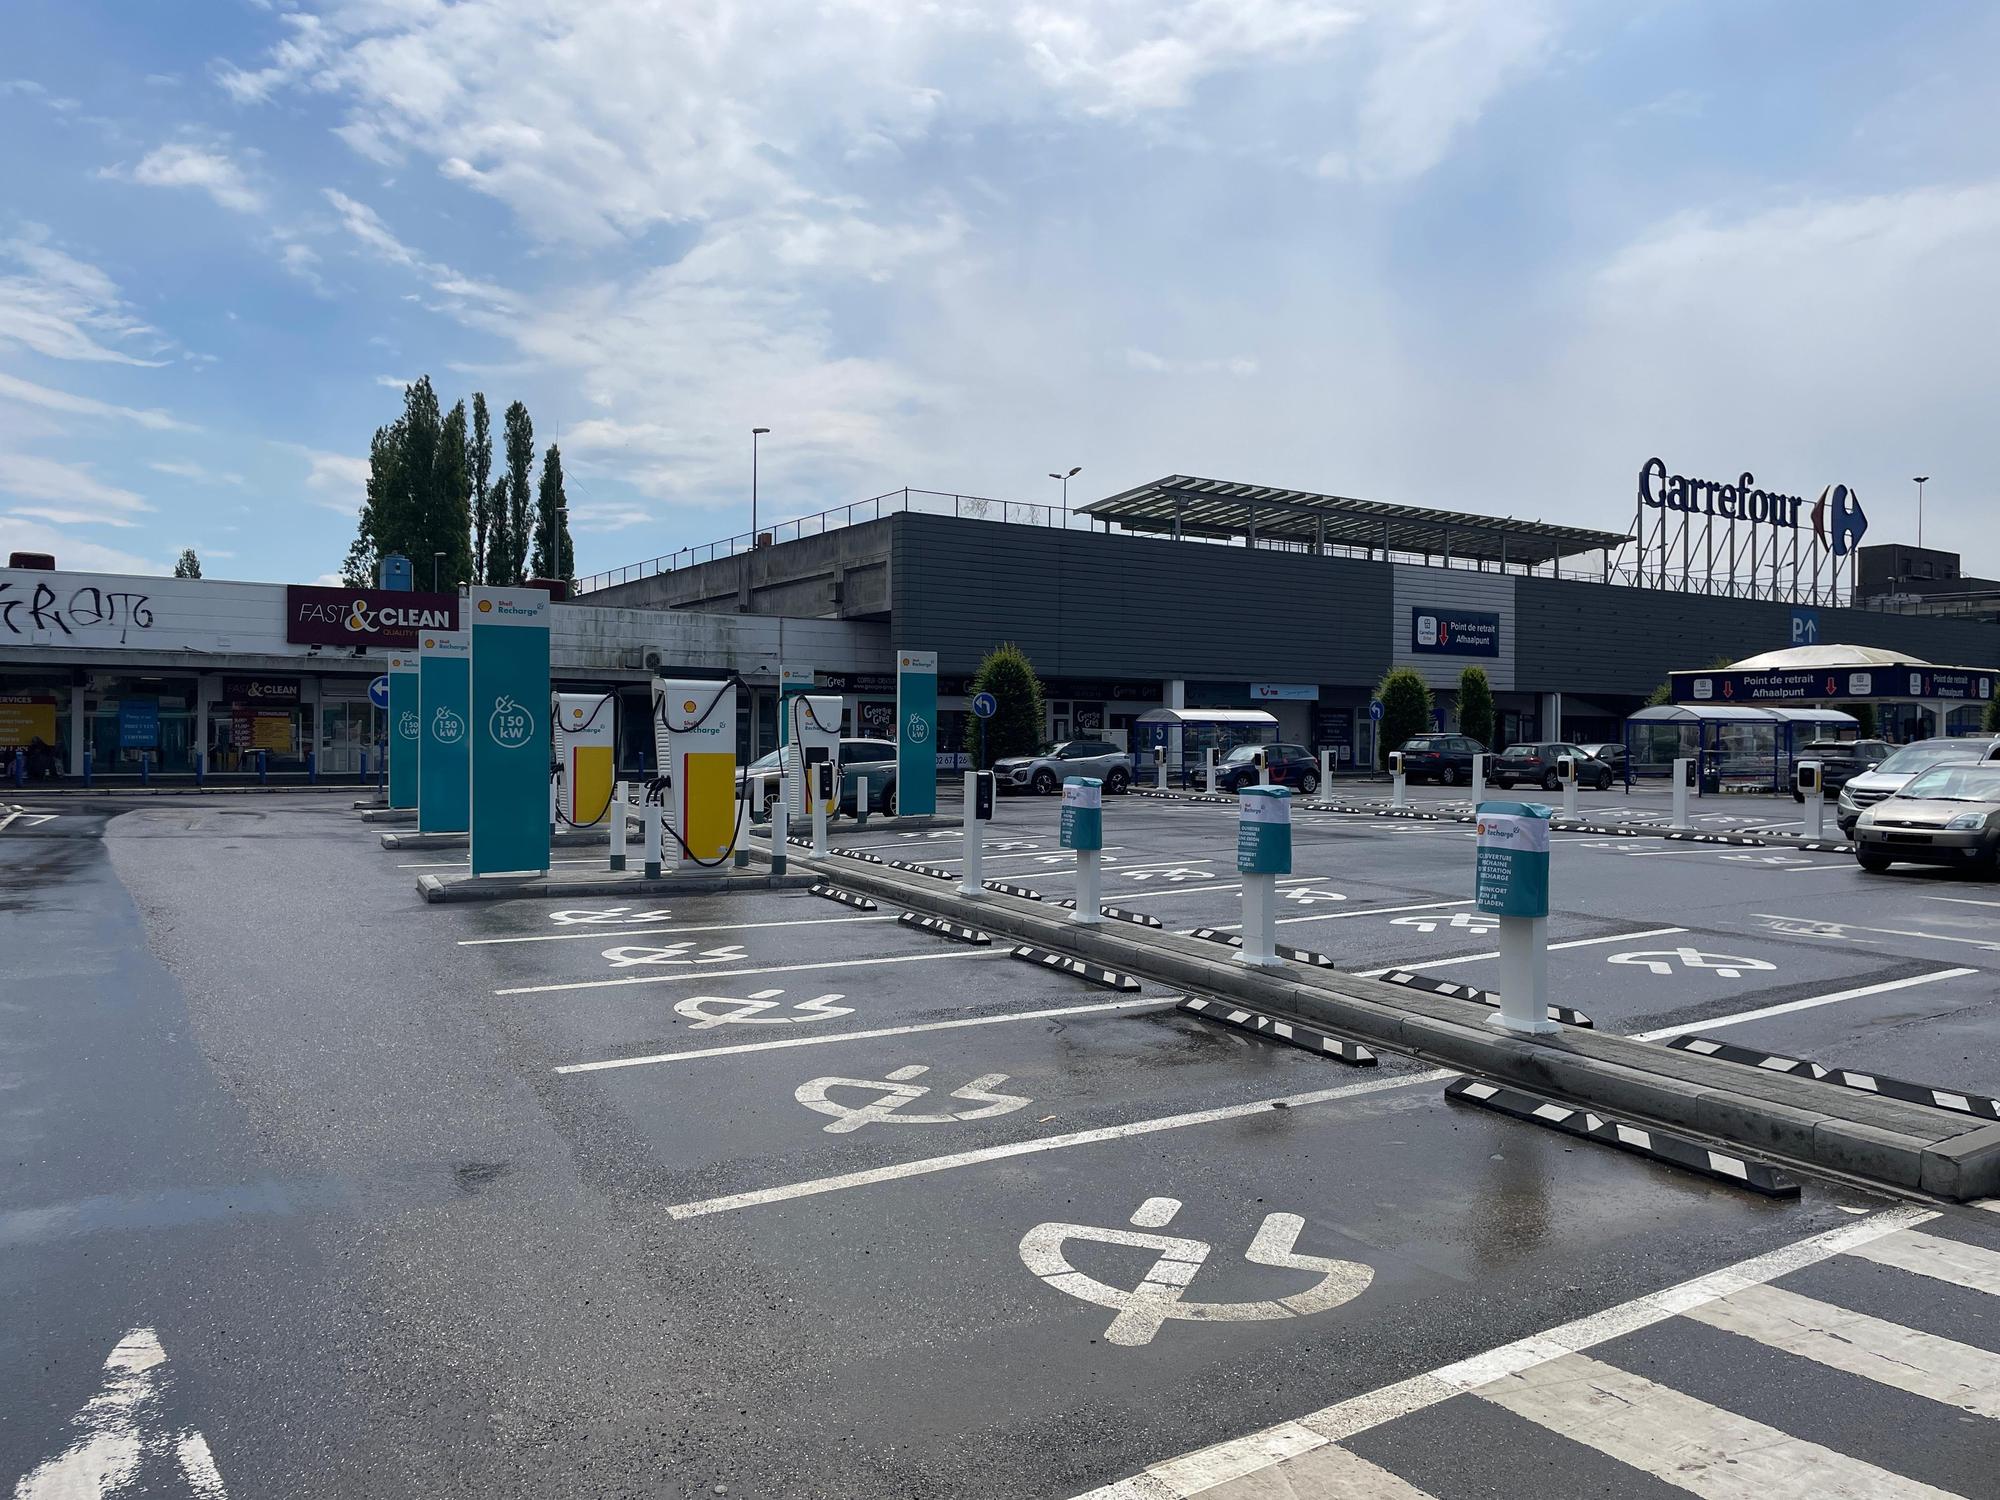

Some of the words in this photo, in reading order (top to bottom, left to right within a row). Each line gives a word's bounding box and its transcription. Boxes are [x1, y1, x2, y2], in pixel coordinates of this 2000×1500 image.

[1641, 457, 1801, 528] Carrefour
[498, 606, 538, 616] Recharge
[1450, 621, 1467, 631] Point
[1467, 623, 1477, 632] de
[1477, 624, 1495, 633] retrait
[1456, 634, 1490, 646] Afhaalpunt
[827, 676, 846, 688] Greg
[1743, 676, 1768, 685] Point
[1769, 676, 1783, 684] de
[1784, 673, 1815, 684] retrait
[1752, 687, 1805, 698] Afhaalpunt
[439, 720, 457, 729] 150
[500, 716, 524, 727] 150
[873, 715, 890, 725] Greg
[440, 728, 457, 736] kW
[500, 727, 524, 738] kW
[912, 724, 924, 732] 150
[1156, 727, 1164, 740] 5
